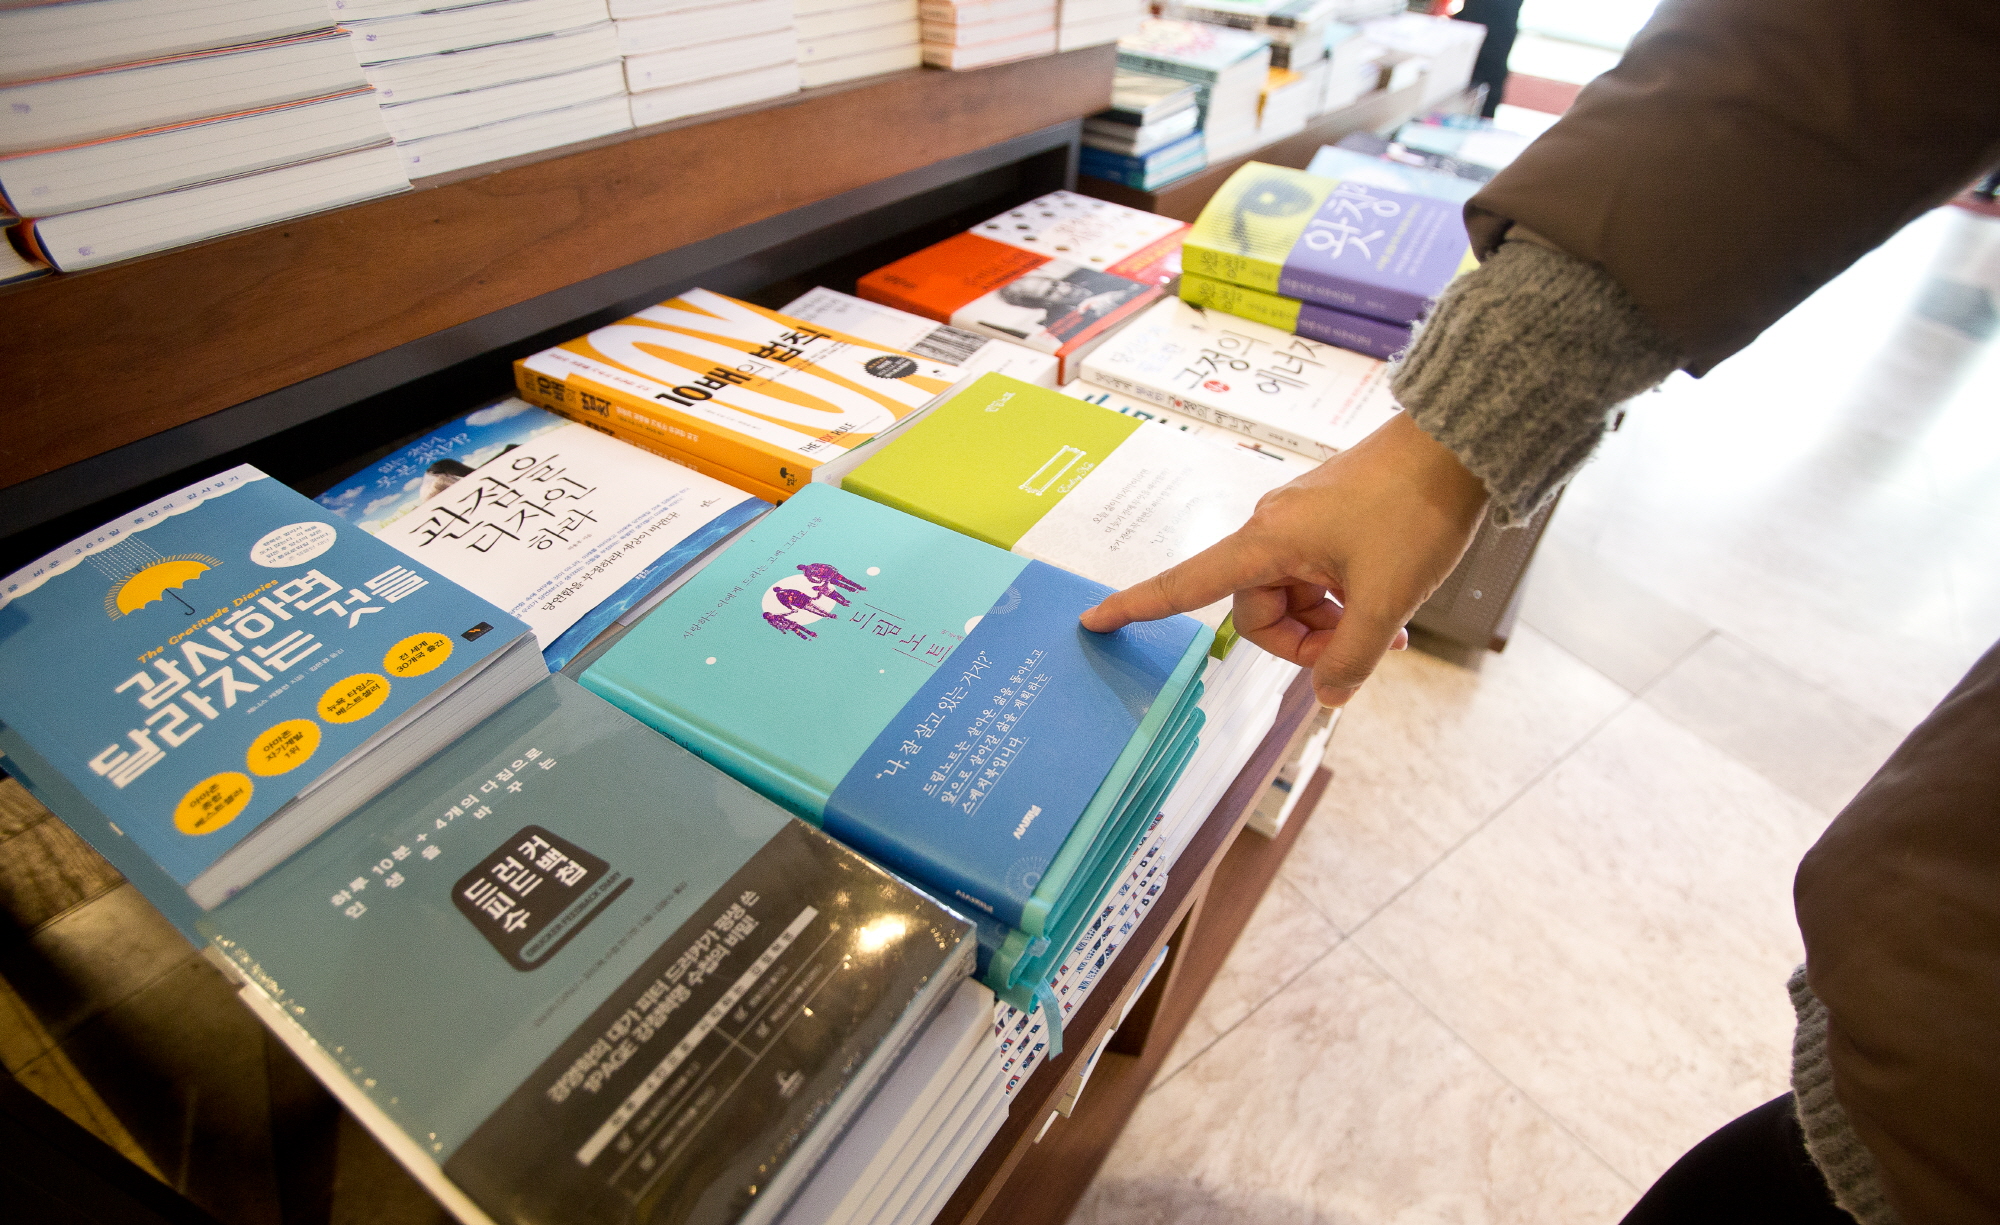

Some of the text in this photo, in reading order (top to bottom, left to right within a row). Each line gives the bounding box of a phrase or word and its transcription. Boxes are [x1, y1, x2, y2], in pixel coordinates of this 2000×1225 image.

[1305, 184, 1401, 260] 왓칭
[654, 359, 773, 407] 10배의
[750, 325, 835, 363] 법칙
[1254, 339, 1326, 395] 에너지
[798, 420, 858, 452] THE 10X RULE
[409, 453, 566, 548] 관점을
[466, 477, 597, 552] 디자인
[527, 509, 598, 550] 하라
[1091, 508, 1108, 525] 오늘
[541, 581, 584, 611] 당연함을
[582, 551, 624, 581] 부정하라!
[623, 530, 652, 553] 세상이
[683, 609, 717, 640] 사랑하는
[717, 585, 743, 609] 이에게
[743, 565, 769, 586] 드리는
[766, 549, 786, 565] 고백
[784, 530, 808, 549] 그리고
[114, 568, 344, 710] 감사하면
[137, 579, 279, 664] The Gratitude Diaries
[396, 639, 445, 673] 30개국 출간
[398, 640, 429, 662] 전 세계
[849, 610, 954, 664] 드림노트
[88, 564, 430, 789] 달라지는 것들
[326, 678, 376, 713] 뉴욕 타임스
[335, 682, 381, 717] 베스트셀러
[262, 729, 292, 753] 아마존
[265, 731, 304, 762] 자기계발
[283, 745, 300, 760] 1위
[900, 740, 923, 756] 잘
[913, 713, 947, 739] 살고
[938, 686, 969, 713] 있는
[923, 649, 1043, 797] 드림노트는 살아온 삶을 돌아보고
[940, 673, 1048, 805] 앞으로 살아갈 삶을 계획하는
[189, 782, 219, 808] 아마존
[194, 787, 245, 829] 베스트셀러
[961, 736, 1026, 814] 스케치북입니다.
[330, 876, 370, 908] 하루
[480, 747, 544, 795] 다짐으로
[463, 834, 551, 907] 드러커
[482, 849, 569, 922] 피드백
[606, 1008, 642, 1042] 대가
[635, 979, 670, 1012] 피터
[664, 928, 720, 984] 드러커가
[713, 902, 746, 932] 평생
[687, 943, 731, 986] 수첩의
